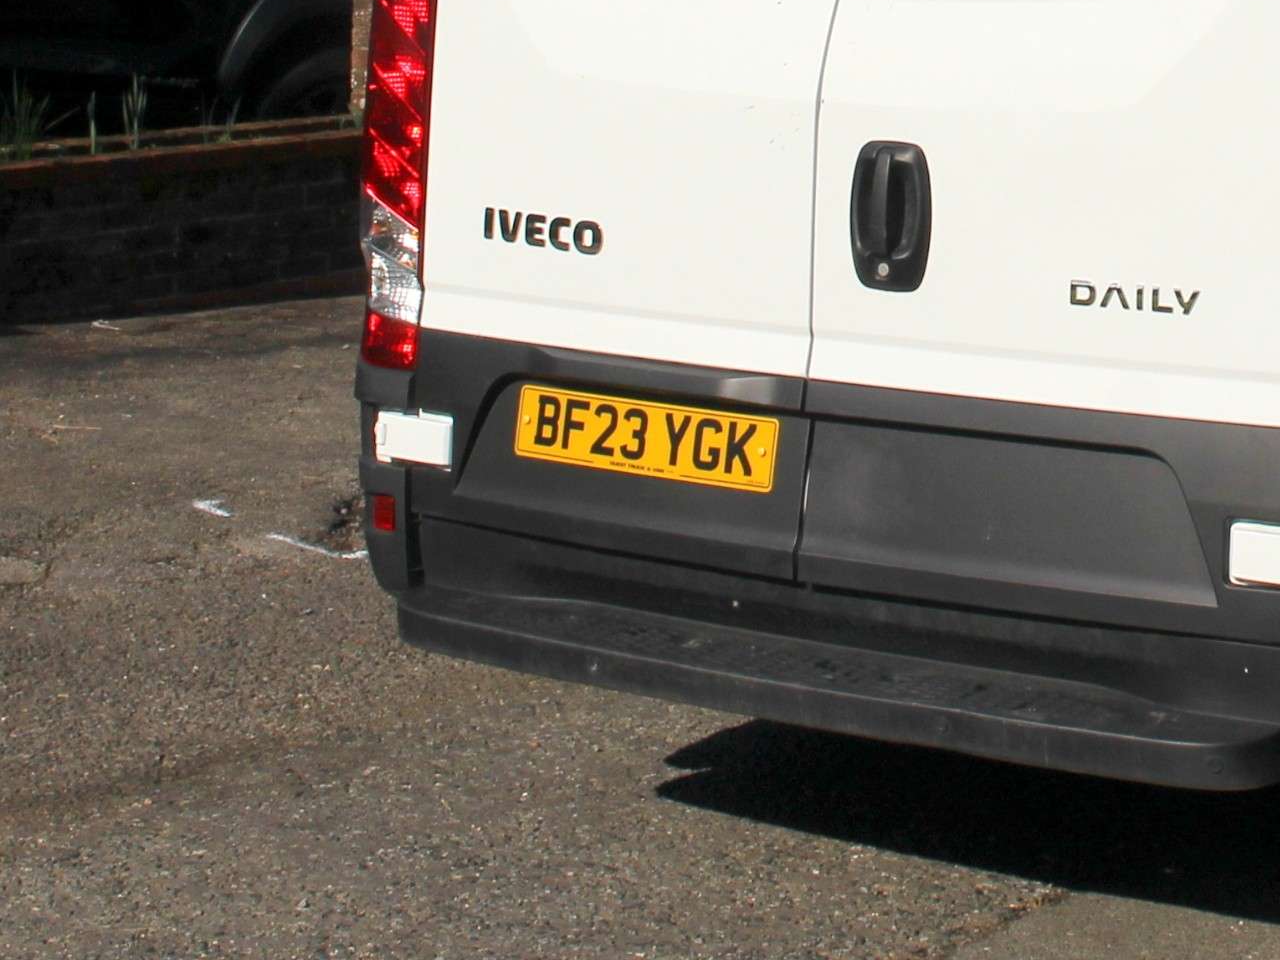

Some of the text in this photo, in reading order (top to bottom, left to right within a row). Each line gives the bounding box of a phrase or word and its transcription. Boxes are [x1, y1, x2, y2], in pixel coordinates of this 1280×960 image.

[483, 206, 604, 256] IVECO
[1069, 279, 1201, 316] DAILY
[533, 394, 758, 477] BF23 YGK
